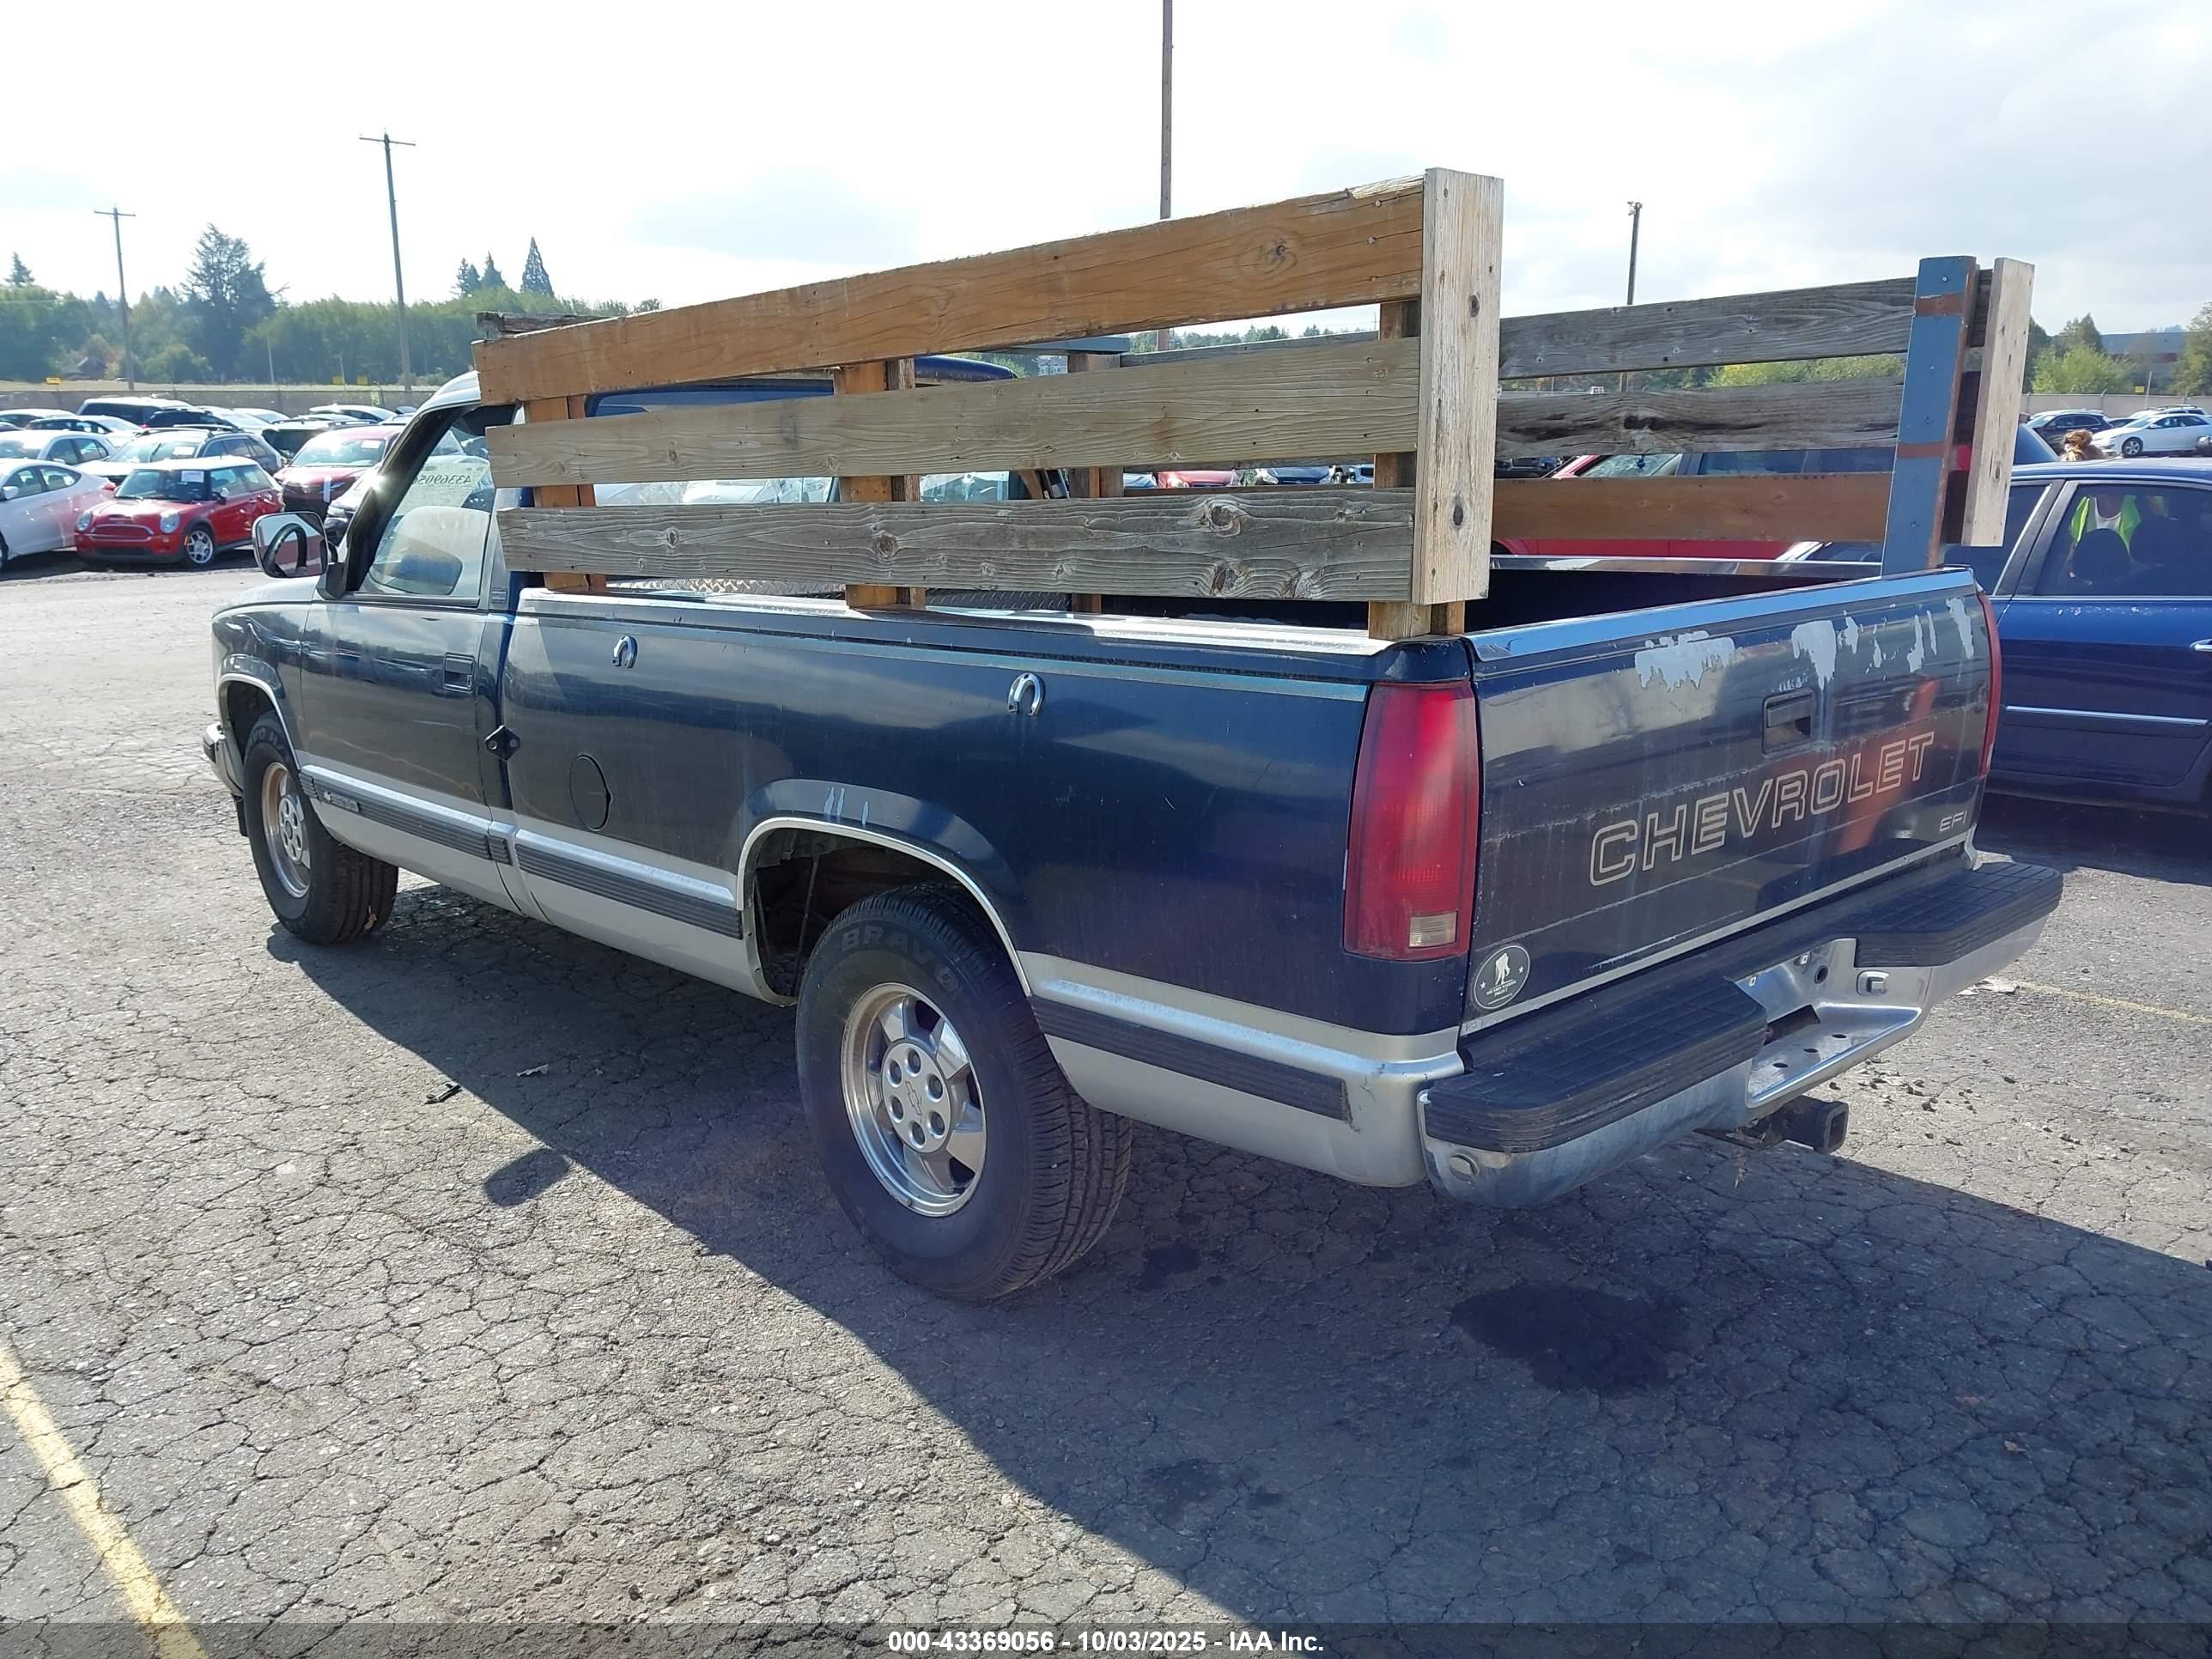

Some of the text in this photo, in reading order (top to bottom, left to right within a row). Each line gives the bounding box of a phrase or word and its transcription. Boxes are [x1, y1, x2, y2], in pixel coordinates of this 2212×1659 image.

[1589, 732, 1935, 886] CHEVROLET
[1939, 810, 1967, 832] EFI
[841, 925, 959, 992] BRAVO
